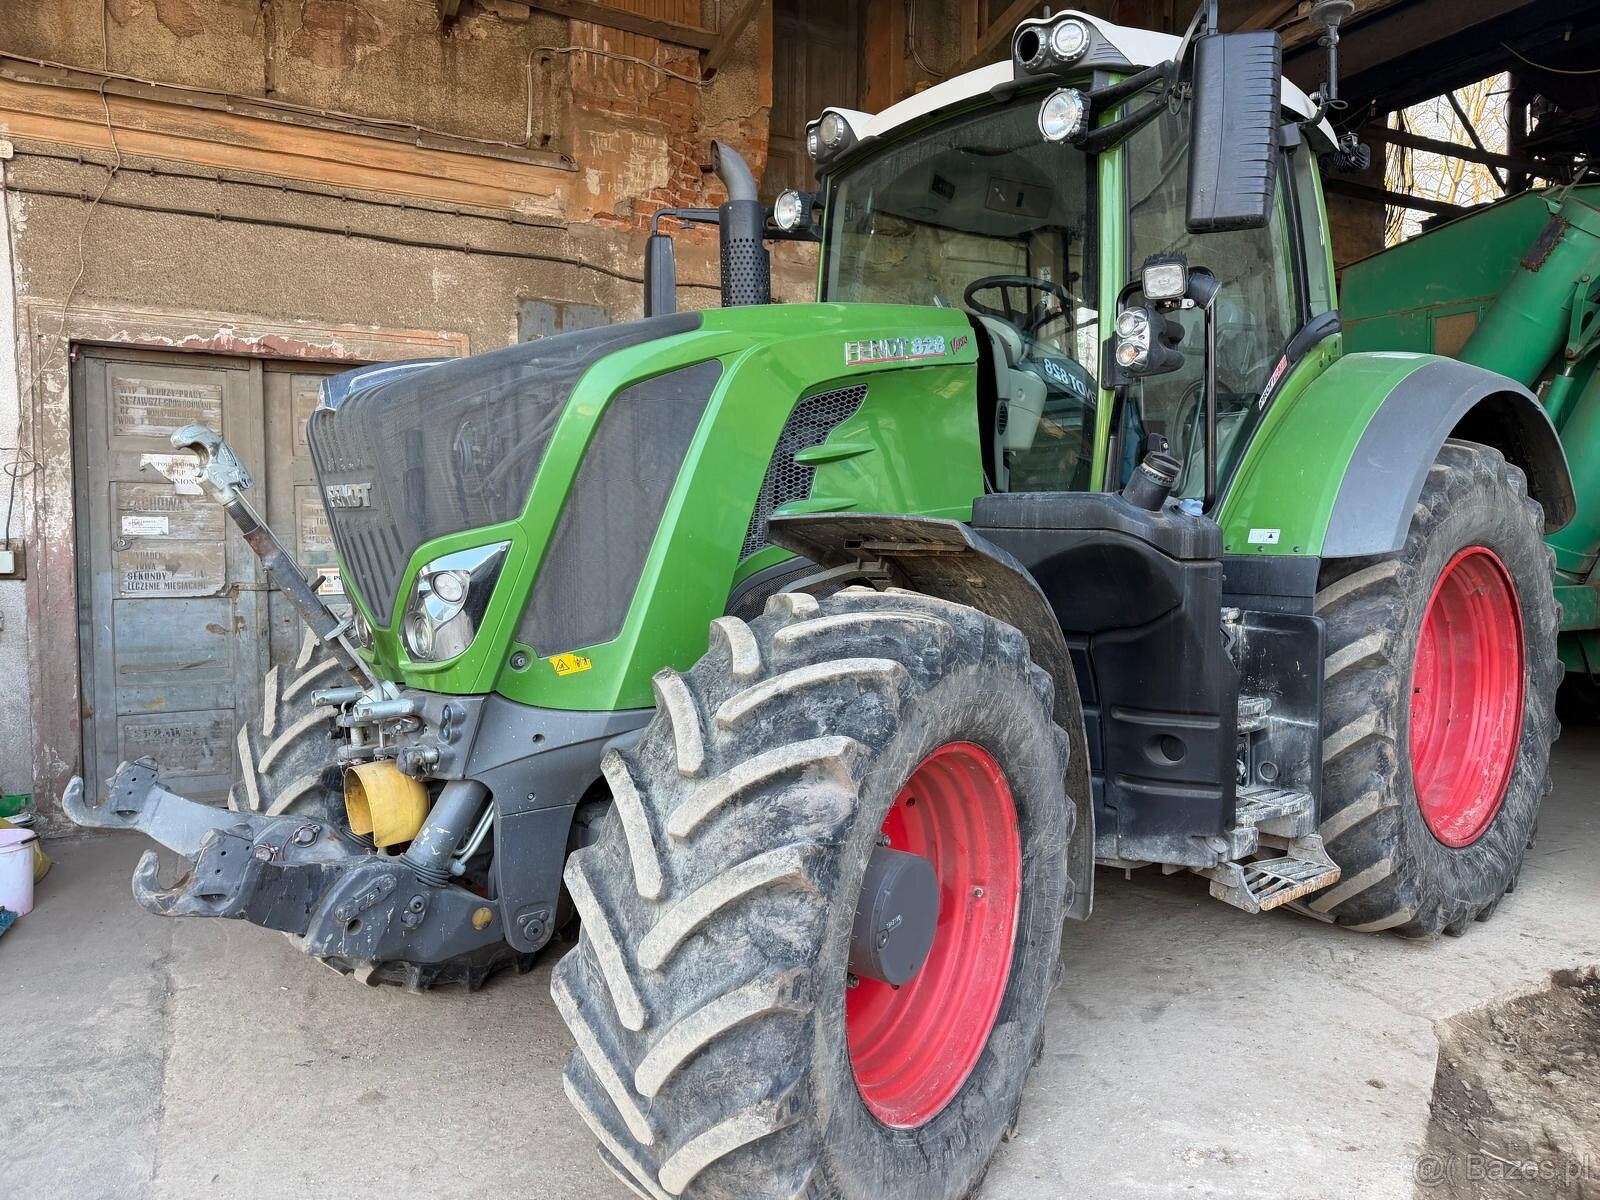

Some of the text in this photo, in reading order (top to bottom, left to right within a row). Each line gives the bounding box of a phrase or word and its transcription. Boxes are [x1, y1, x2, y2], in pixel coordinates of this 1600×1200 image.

[844, 337, 908, 365] FENDT
[911, 335, 945, 355] 828
[127, 571, 168, 581] SEKUNDY
